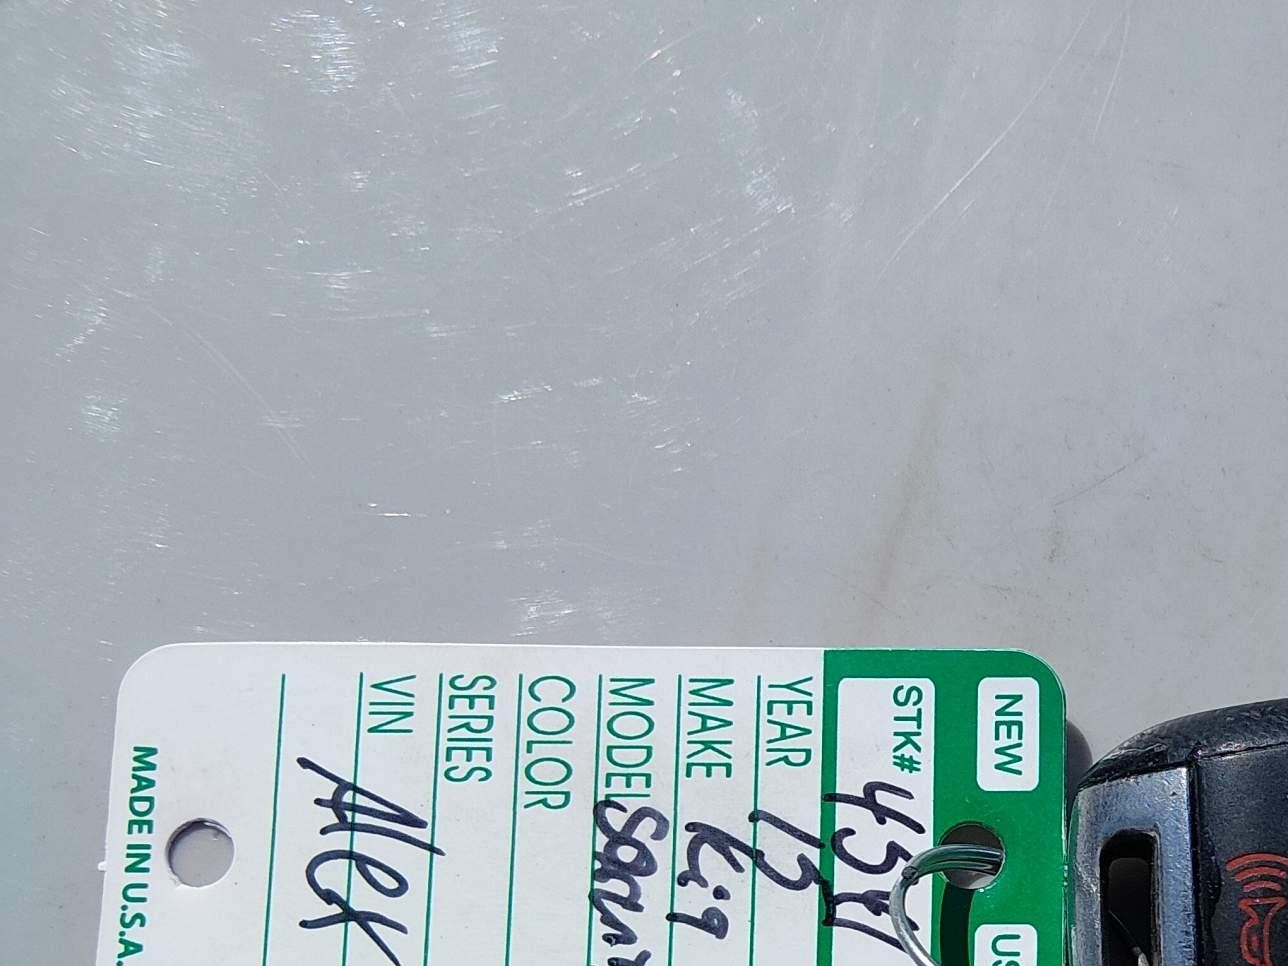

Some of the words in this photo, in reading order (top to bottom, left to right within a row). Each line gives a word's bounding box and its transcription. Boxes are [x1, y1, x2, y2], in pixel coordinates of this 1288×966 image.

[367, 676, 416, 735] VIN
[443, 675, 498, 783] SERIES
[524, 676, 577, 810] COLOR
[605, 677, 656, 801] MODEL
[685, 678, 735, 779] MAKE
[766, 677, 814, 767] YEAR
[893, 685, 924, 774] STK#
[994, 694, 1025, 777] NEW
[128, 746, 158, 835] MADE
[124, 843, 152, 873] IN
